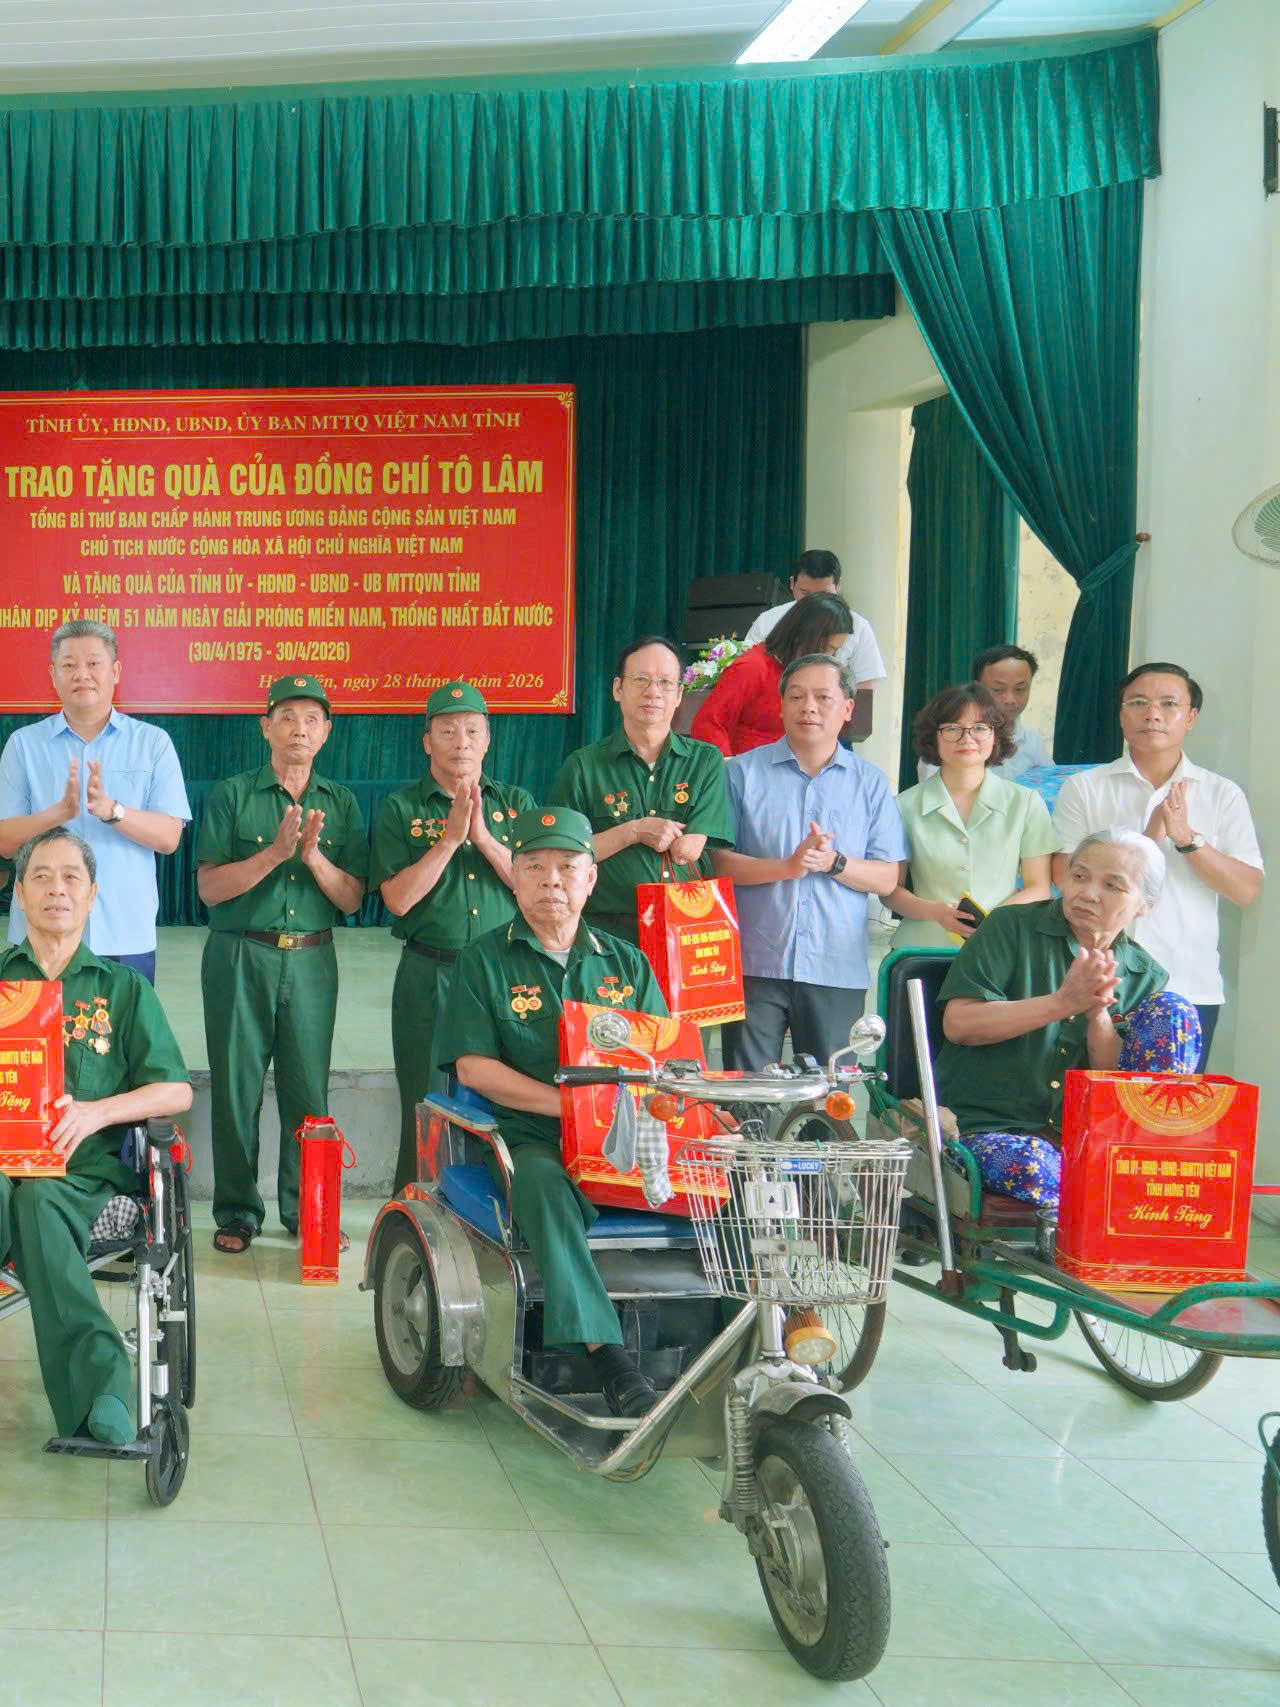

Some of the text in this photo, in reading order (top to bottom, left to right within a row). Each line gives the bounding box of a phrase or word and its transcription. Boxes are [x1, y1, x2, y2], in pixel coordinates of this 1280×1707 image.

[26, 408, 521, 434] TỈNH ỦY, HĐND, UBND, ỦY BAN MTTQ VIỆT NAM TỈNH
[4, 451, 543, 504] TRAO TẶNG QUÀ CỦA ĐỒNG CHÍ TÔ LÂM
[30, 504, 517, 529] TỔNG BÍ THƯ BAN CHẤP HÀNH TRUNG ƯƠNG ĐẢNG CỘNG SẢN VIỆT NAM
[80, 532, 463, 559] CHỦ TỊCH NƯỚC CỘNG HÒA XÃ HỘI CHỦ NGHĨA VIỆT NAM
[63, 570, 81, 594] VÀ
[85, 570, 120, 598] TẶNG
[125, 570, 154, 595] QUÀ
[157, 568, 185, 594] CỦA
[189, 568, 220, 593] TỈNH
[225, 568, 243, 593] ỦY
[257, 573, 296, 593] HĐND
[310, 573, 349, 593] UBND
[363, 573, 382, 593] UB
[386, 572, 443, 594] MTTQVN
[447, 566, 480, 593] TỈNH
[35, 608, 57, 632] DỊP
[62, 601, 80, 624] KỶ
[124, 608, 140, 627] 51
[145, 604, 177, 627] NĂM
[181, 604, 219, 627] NGÀY
[223, 601, 251, 627] GIẢI
[255, 603, 303, 627] PHÓNG
[308, 602, 346, 627] MIỀN
[349, 607, 386, 629] NAM,
[391, 600, 437, 627] THỐNG
[441, 600, 480, 626] NHẤT
[482, 599, 510, 626] ĐẤT
[514, 603, 553, 626] NƯỚC
[189, 641, 263, 662] (30/4/1975
[276, 641, 350, 661] 30/4/2026)
[343, 672, 380, 692] ngày
[384, 673, 402, 688] 28
[469, 674, 502, 688] năm
[506, 673, 545, 688] 2026
[1129, 1204, 1213, 1229] Kính Tặng
